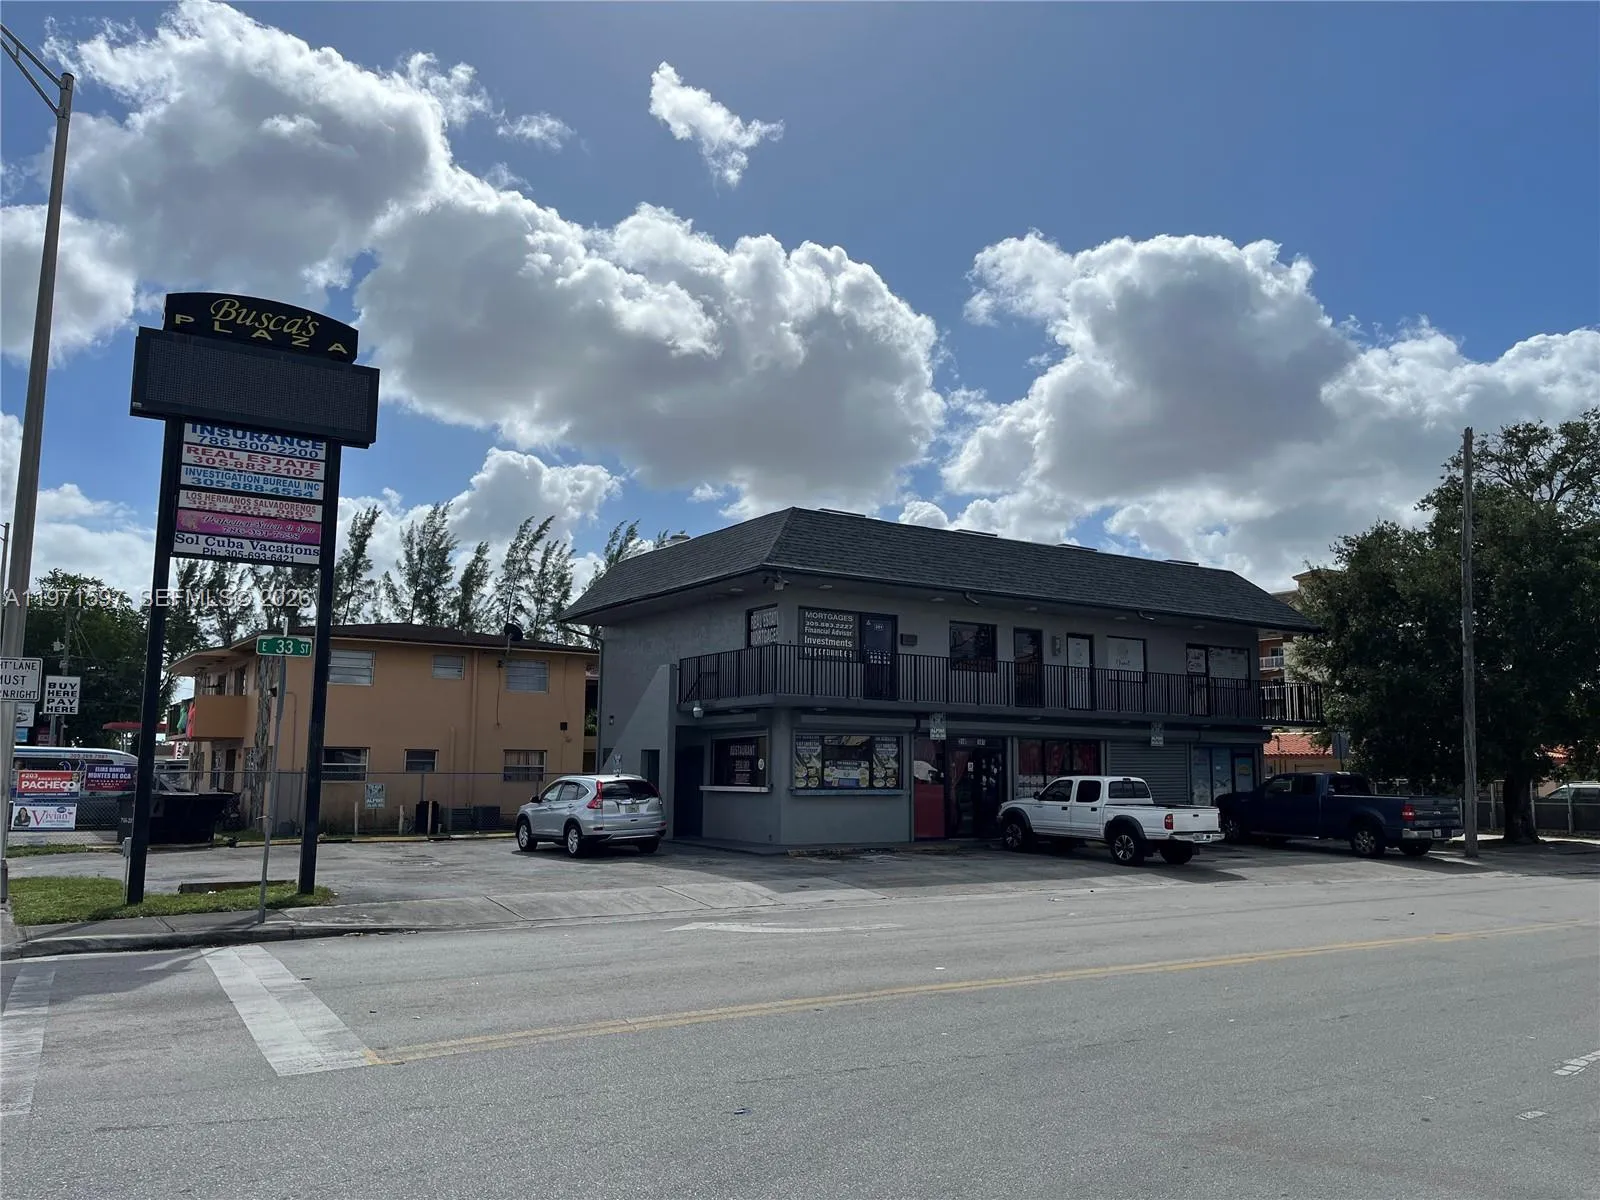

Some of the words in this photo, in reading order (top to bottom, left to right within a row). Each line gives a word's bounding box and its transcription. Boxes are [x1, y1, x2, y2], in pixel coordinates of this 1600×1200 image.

[210, 298, 320, 338] Busca's
[175, 314, 348, 354] PLAZA
[191, 423, 324, 450] INSURANCE
[197, 435, 319, 459] 786-800-2200
[186, 446, 240, 460] REAL
[247, 454, 321, 470] ESTATE
[193, 456, 315, 478] 305-883-2102
[185, 467, 261, 484] INVESTIGATION
[263, 477, 301, 489] BUREAU
[304, 481, 320, 491] INC
[191, 477, 314, 498] 305-888-4554
[186, 491, 202, 500] LOS
[204, 493, 251, 506] HERMANOS
[175, 533, 200, 545] Sol
[204, 535, 245, 549] Cuba
[249, 540, 320, 556] Vacations
[805, 611, 854, 621] MORTGAGES
[804, 626, 831, 634] Financial
[831, 628, 853, 637] Advisor
[262, 641, 267, 651] E
[276, 639, 293, 654] 33
[300, 643, 309, 654] ST
[804, 635, 853, 647] Investments
[13, 661, 37, 670] LANE
[0, 675, 27, 685] UST
[48, 682, 77, 690] BUY
[10, 690, 37, 698] RIGHT
[46, 705, 76, 713] HERE
[21, 780, 76, 789] PACHECO
